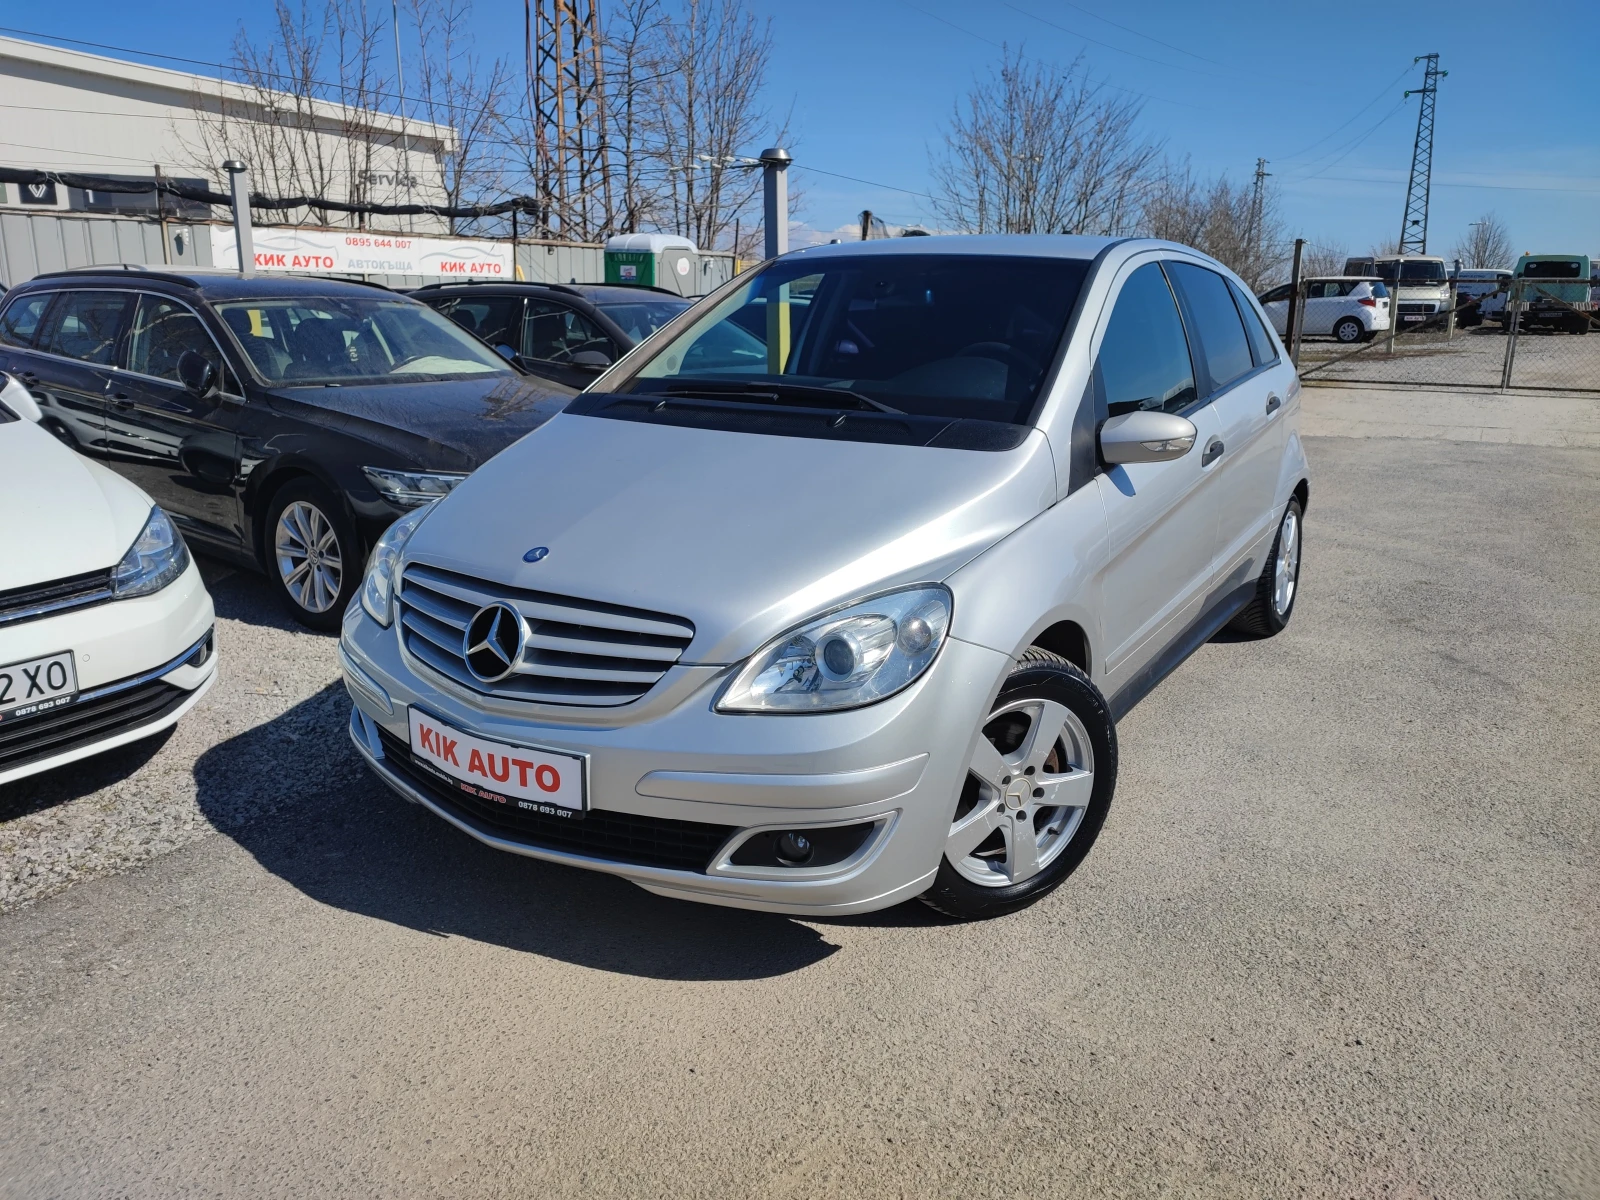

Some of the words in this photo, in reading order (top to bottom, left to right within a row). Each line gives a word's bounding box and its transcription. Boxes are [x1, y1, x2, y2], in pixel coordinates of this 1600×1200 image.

[345, 236, 371, 247] 0895
[374, 239, 392, 248] 644
[395, 240, 412, 249] 007
[254, 253, 287, 267] КИК
[291, 255, 334, 269] АУТО
[347, 258, 413, 273] АВТОКЪЩА
[440, 261, 466, 273] КИК
[470, 262, 502, 274] АУТО
[21, 660, 67, 699] XO
[15, 706, 37, 716] 0878
[38, 701, 54, 710] 693
[55, 696, 71, 706] 007
[419, 723, 460, 768] KIK
[468, 748, 561, 793] AUTO
[518, 801, 538, 811] 0878
[539, 806, 555, 815] 693
[556, 809, 573, 819] 007
